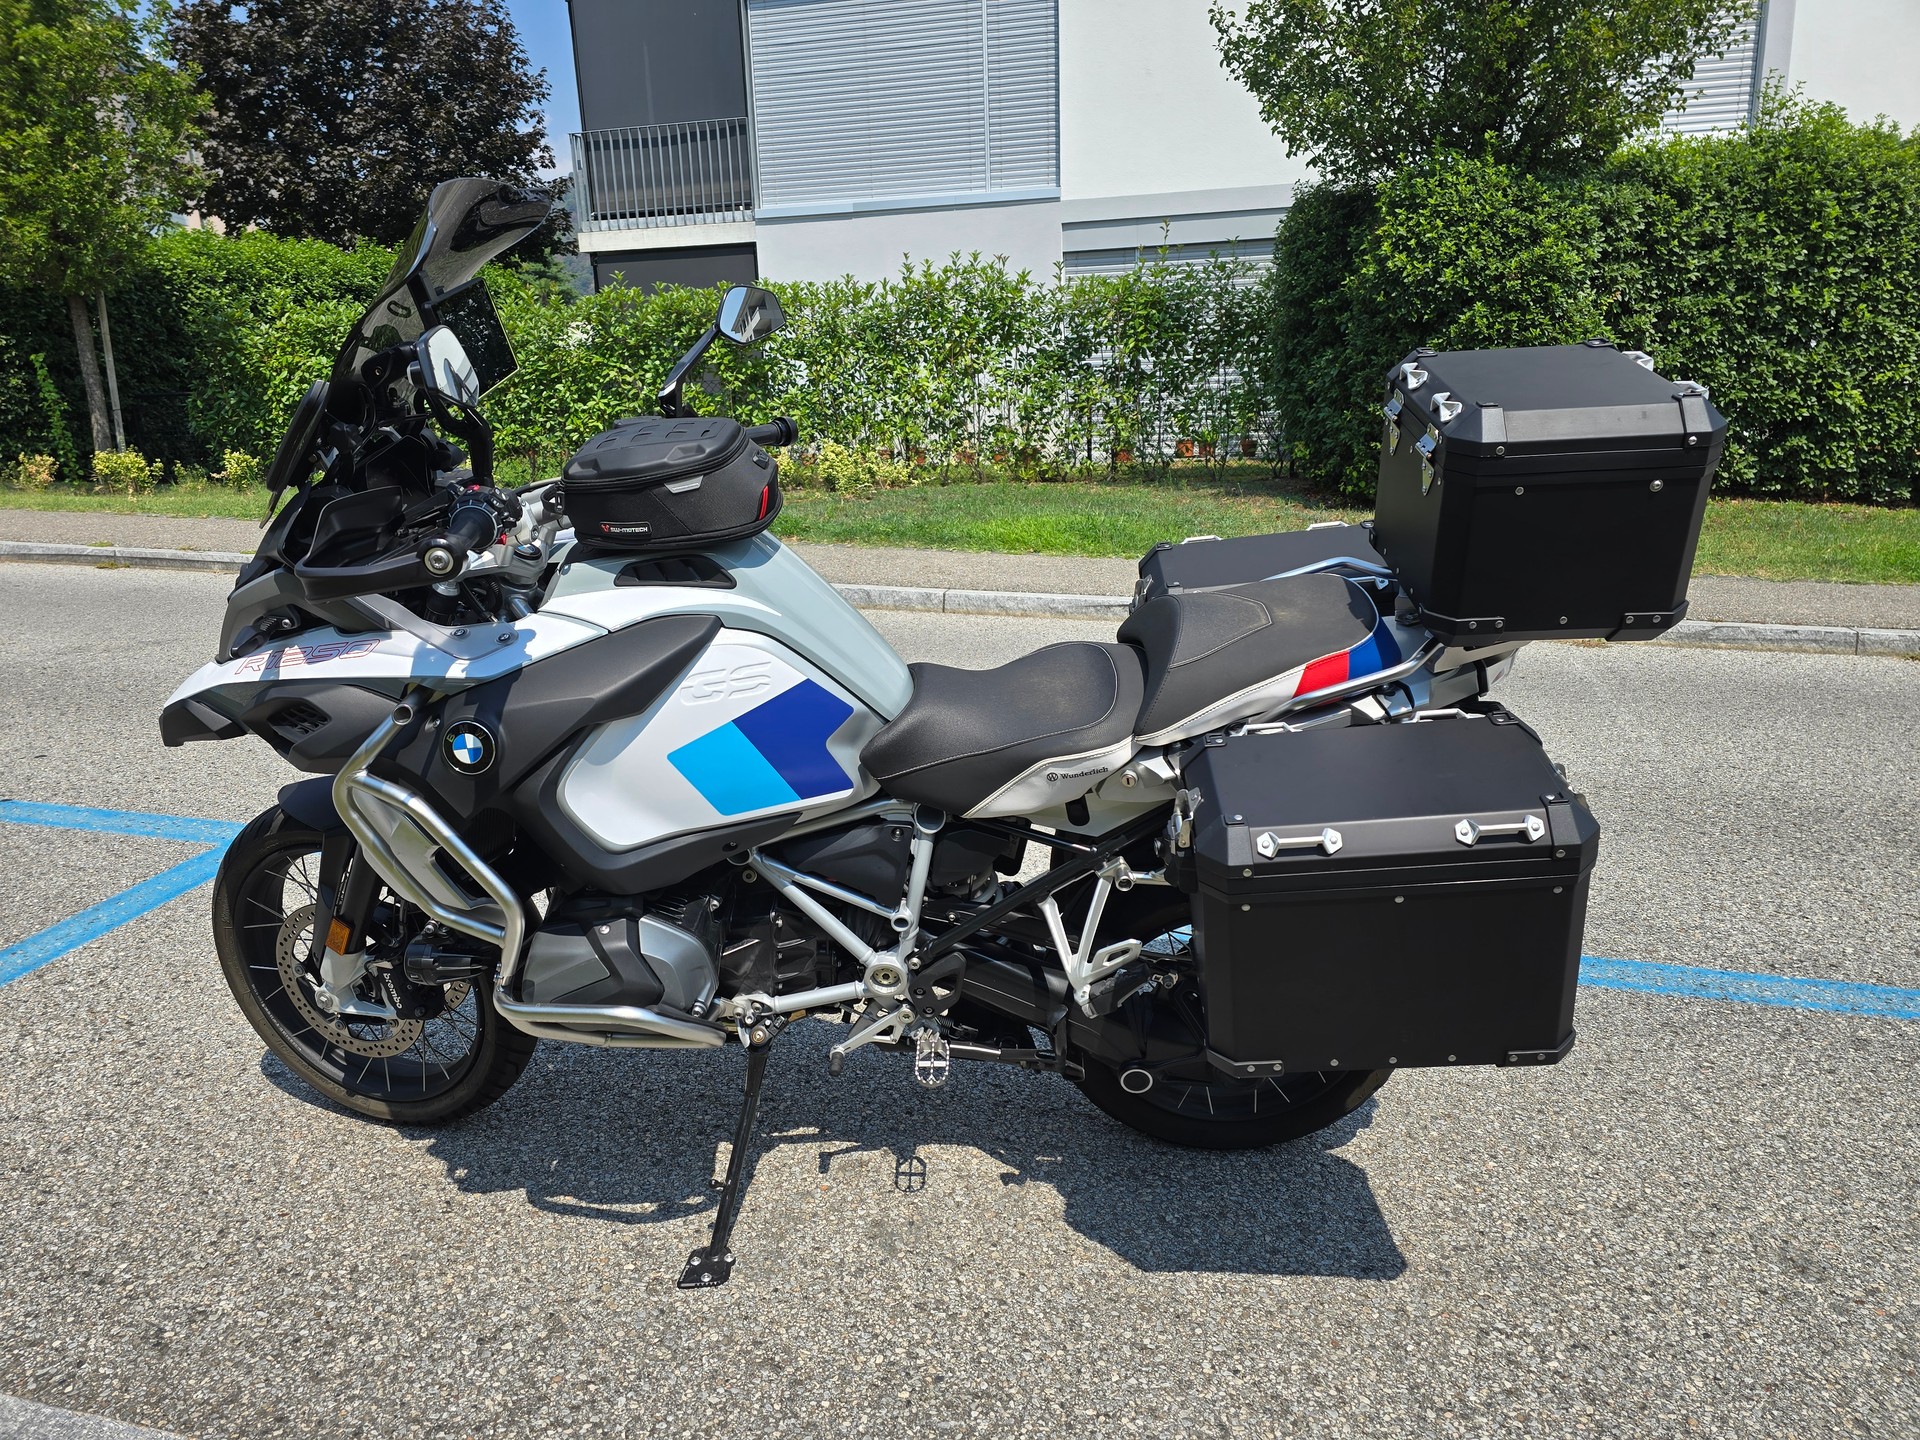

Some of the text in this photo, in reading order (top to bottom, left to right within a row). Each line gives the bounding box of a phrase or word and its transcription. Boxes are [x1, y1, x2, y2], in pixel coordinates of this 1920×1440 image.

[680, 661, 772, 706] GS
[1060, 766, 1109, 780] Wunderlich
[383, 972, 403, 1009] brembo
